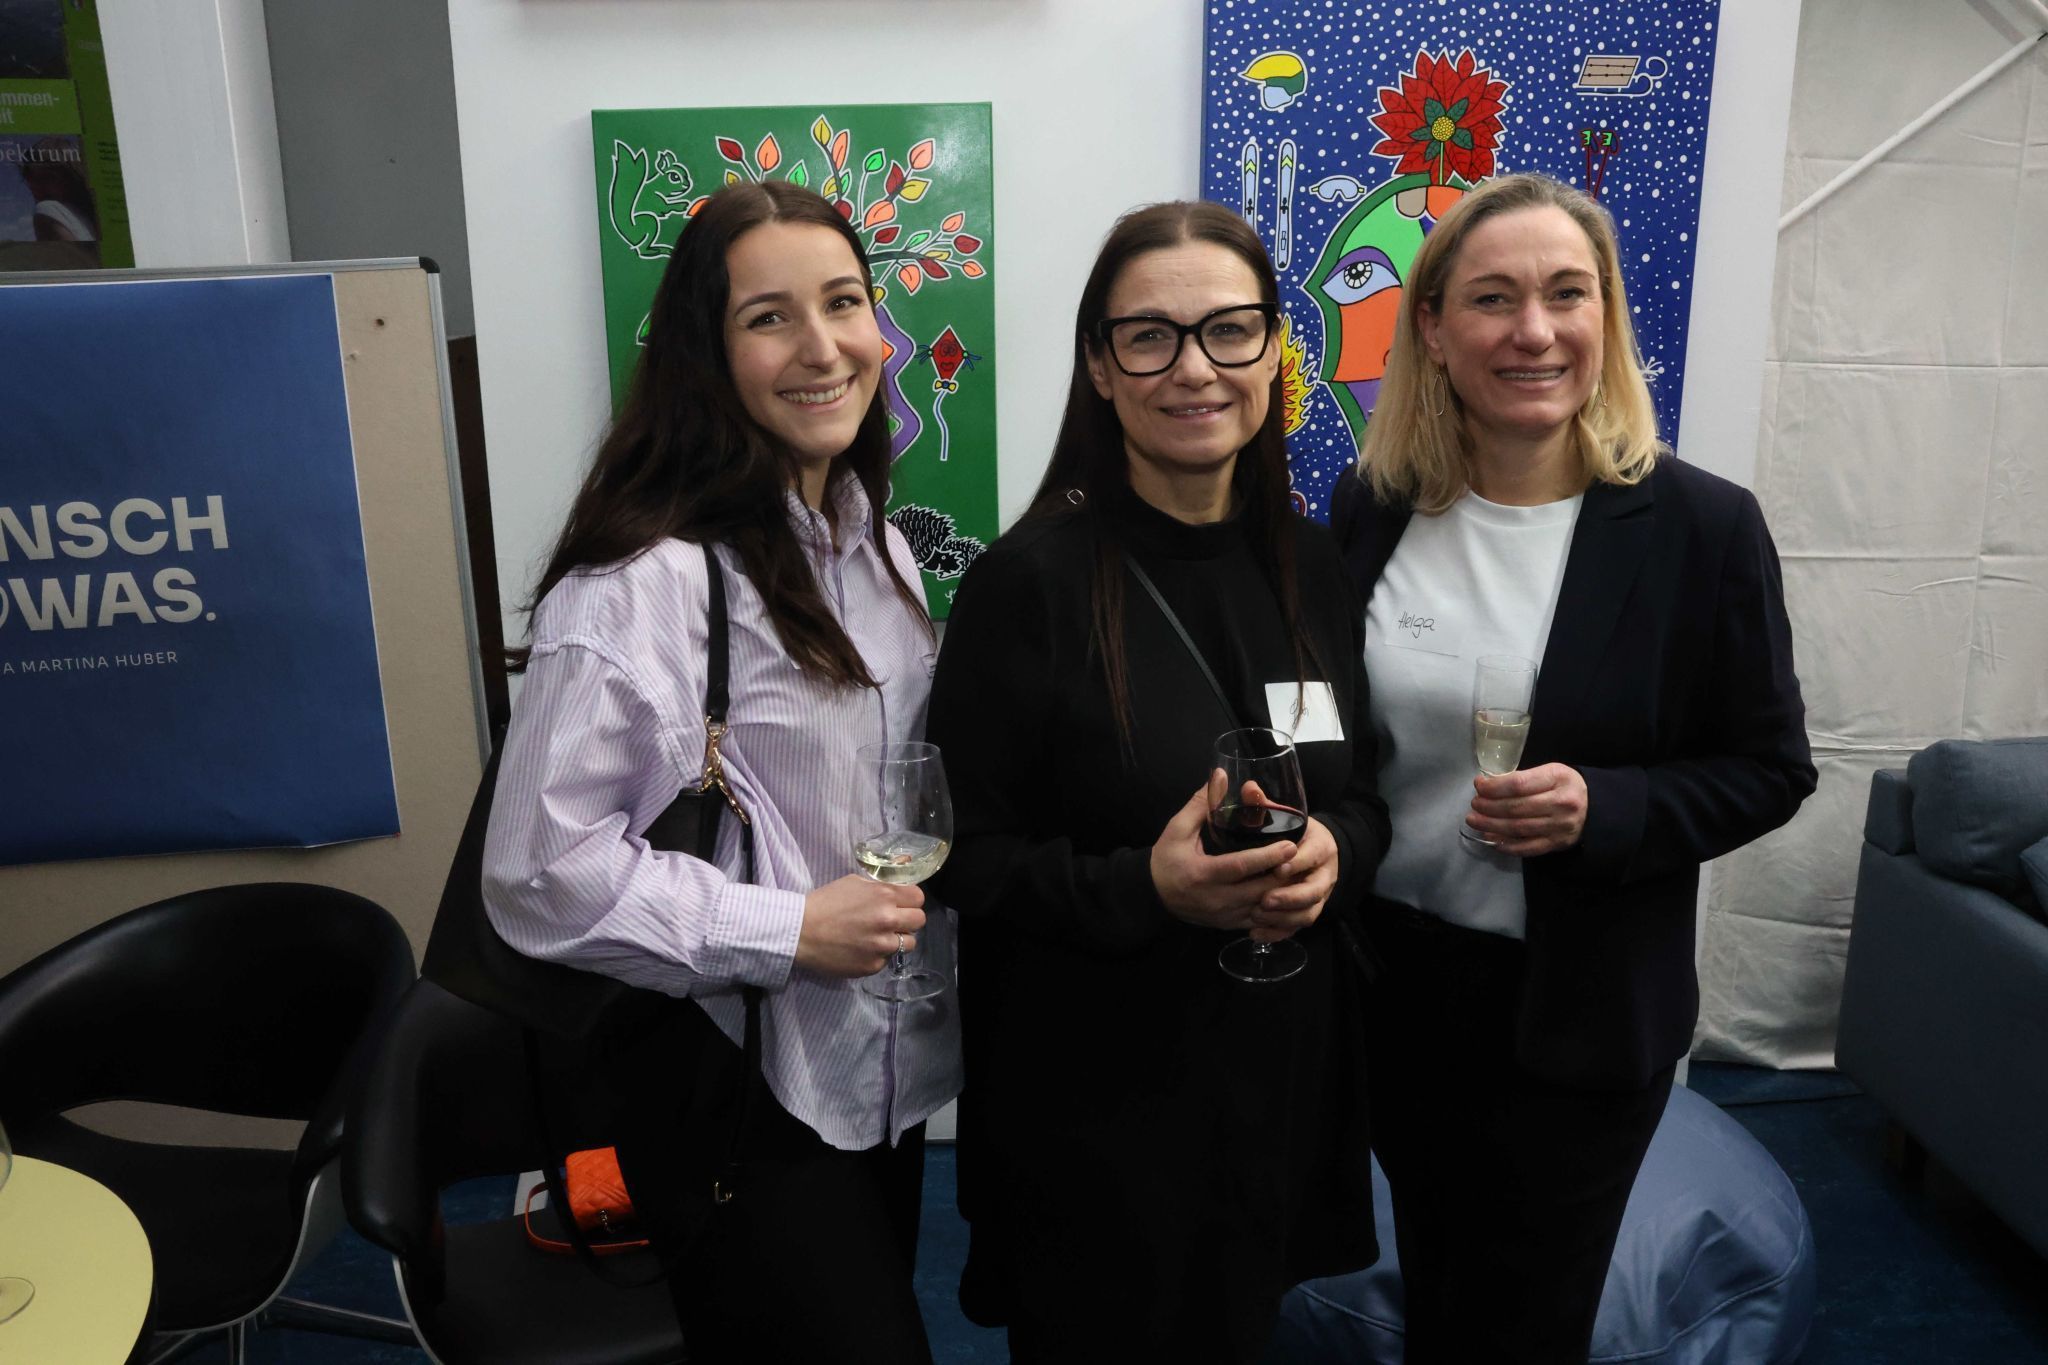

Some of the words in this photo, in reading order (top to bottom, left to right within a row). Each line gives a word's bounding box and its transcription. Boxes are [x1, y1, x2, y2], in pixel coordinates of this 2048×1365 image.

[0, 567, 217, 632] WAS.
[1397, 611, 1436, 639] Helga
[21, 655, 110, 674] MARTINA
[115, 650, 179, 667] HUBER
